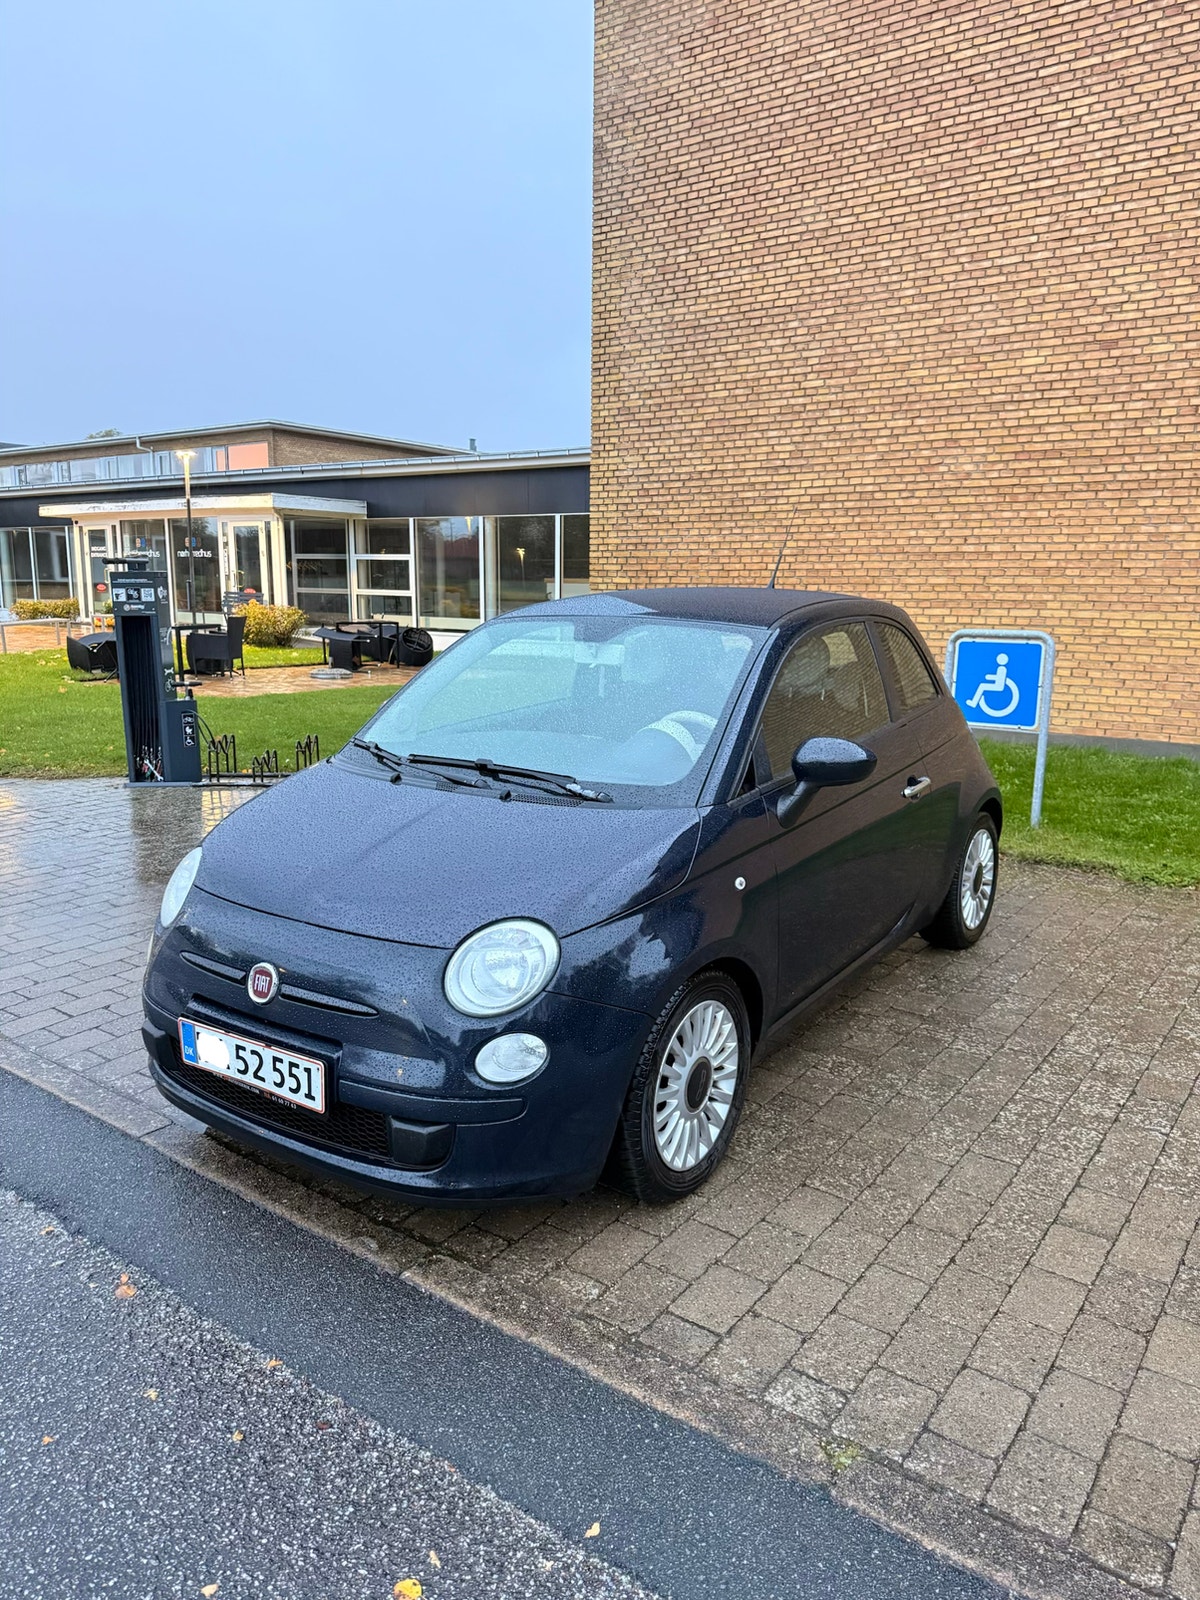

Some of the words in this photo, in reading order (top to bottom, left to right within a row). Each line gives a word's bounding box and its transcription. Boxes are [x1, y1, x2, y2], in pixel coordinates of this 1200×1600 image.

[254, 974, 271, 993] FIAT
[184, 1045, 195, 1057] DK
[235, 1043, 266, 1083] 52
[272, 1055, 316, 1102] 551
